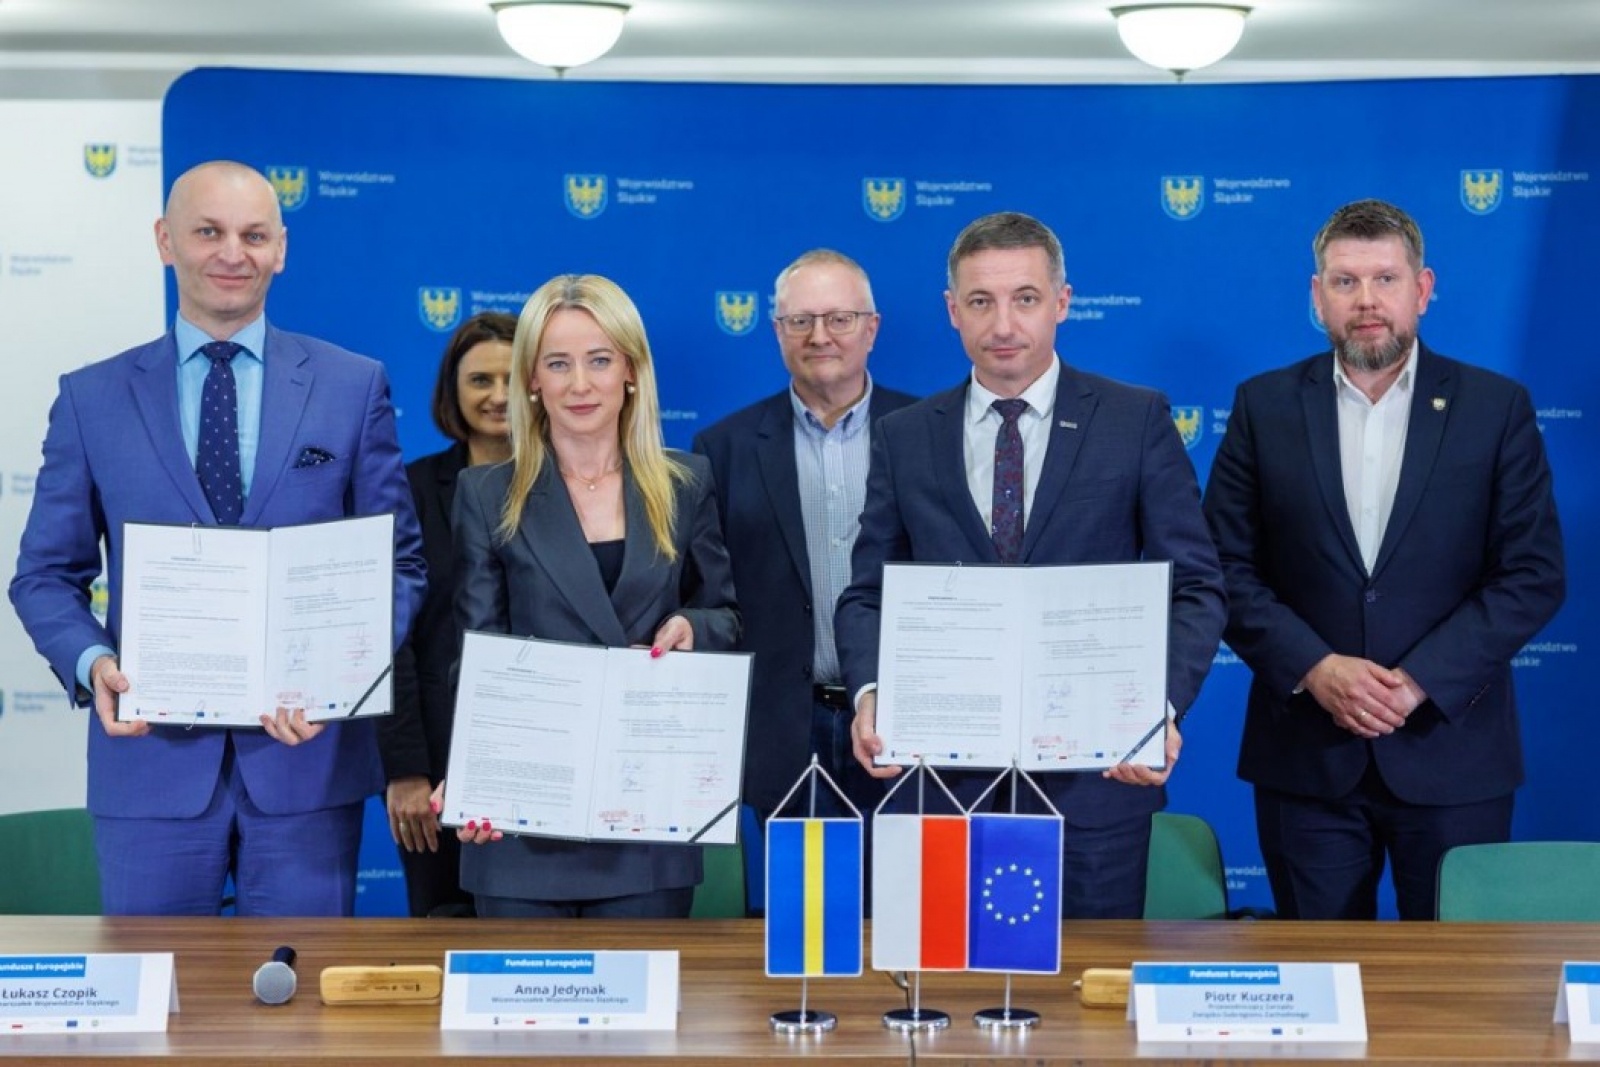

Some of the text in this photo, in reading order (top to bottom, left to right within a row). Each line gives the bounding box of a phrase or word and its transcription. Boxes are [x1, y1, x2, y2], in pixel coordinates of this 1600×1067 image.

[0, 962, 33, 971] undusze
[2, 987, 97, 1002] Łukasz Czopik
[514, 984, 606, 998] Anna Jedynak
[1205, 991, 1294, 1001] Piotr Kuczera
